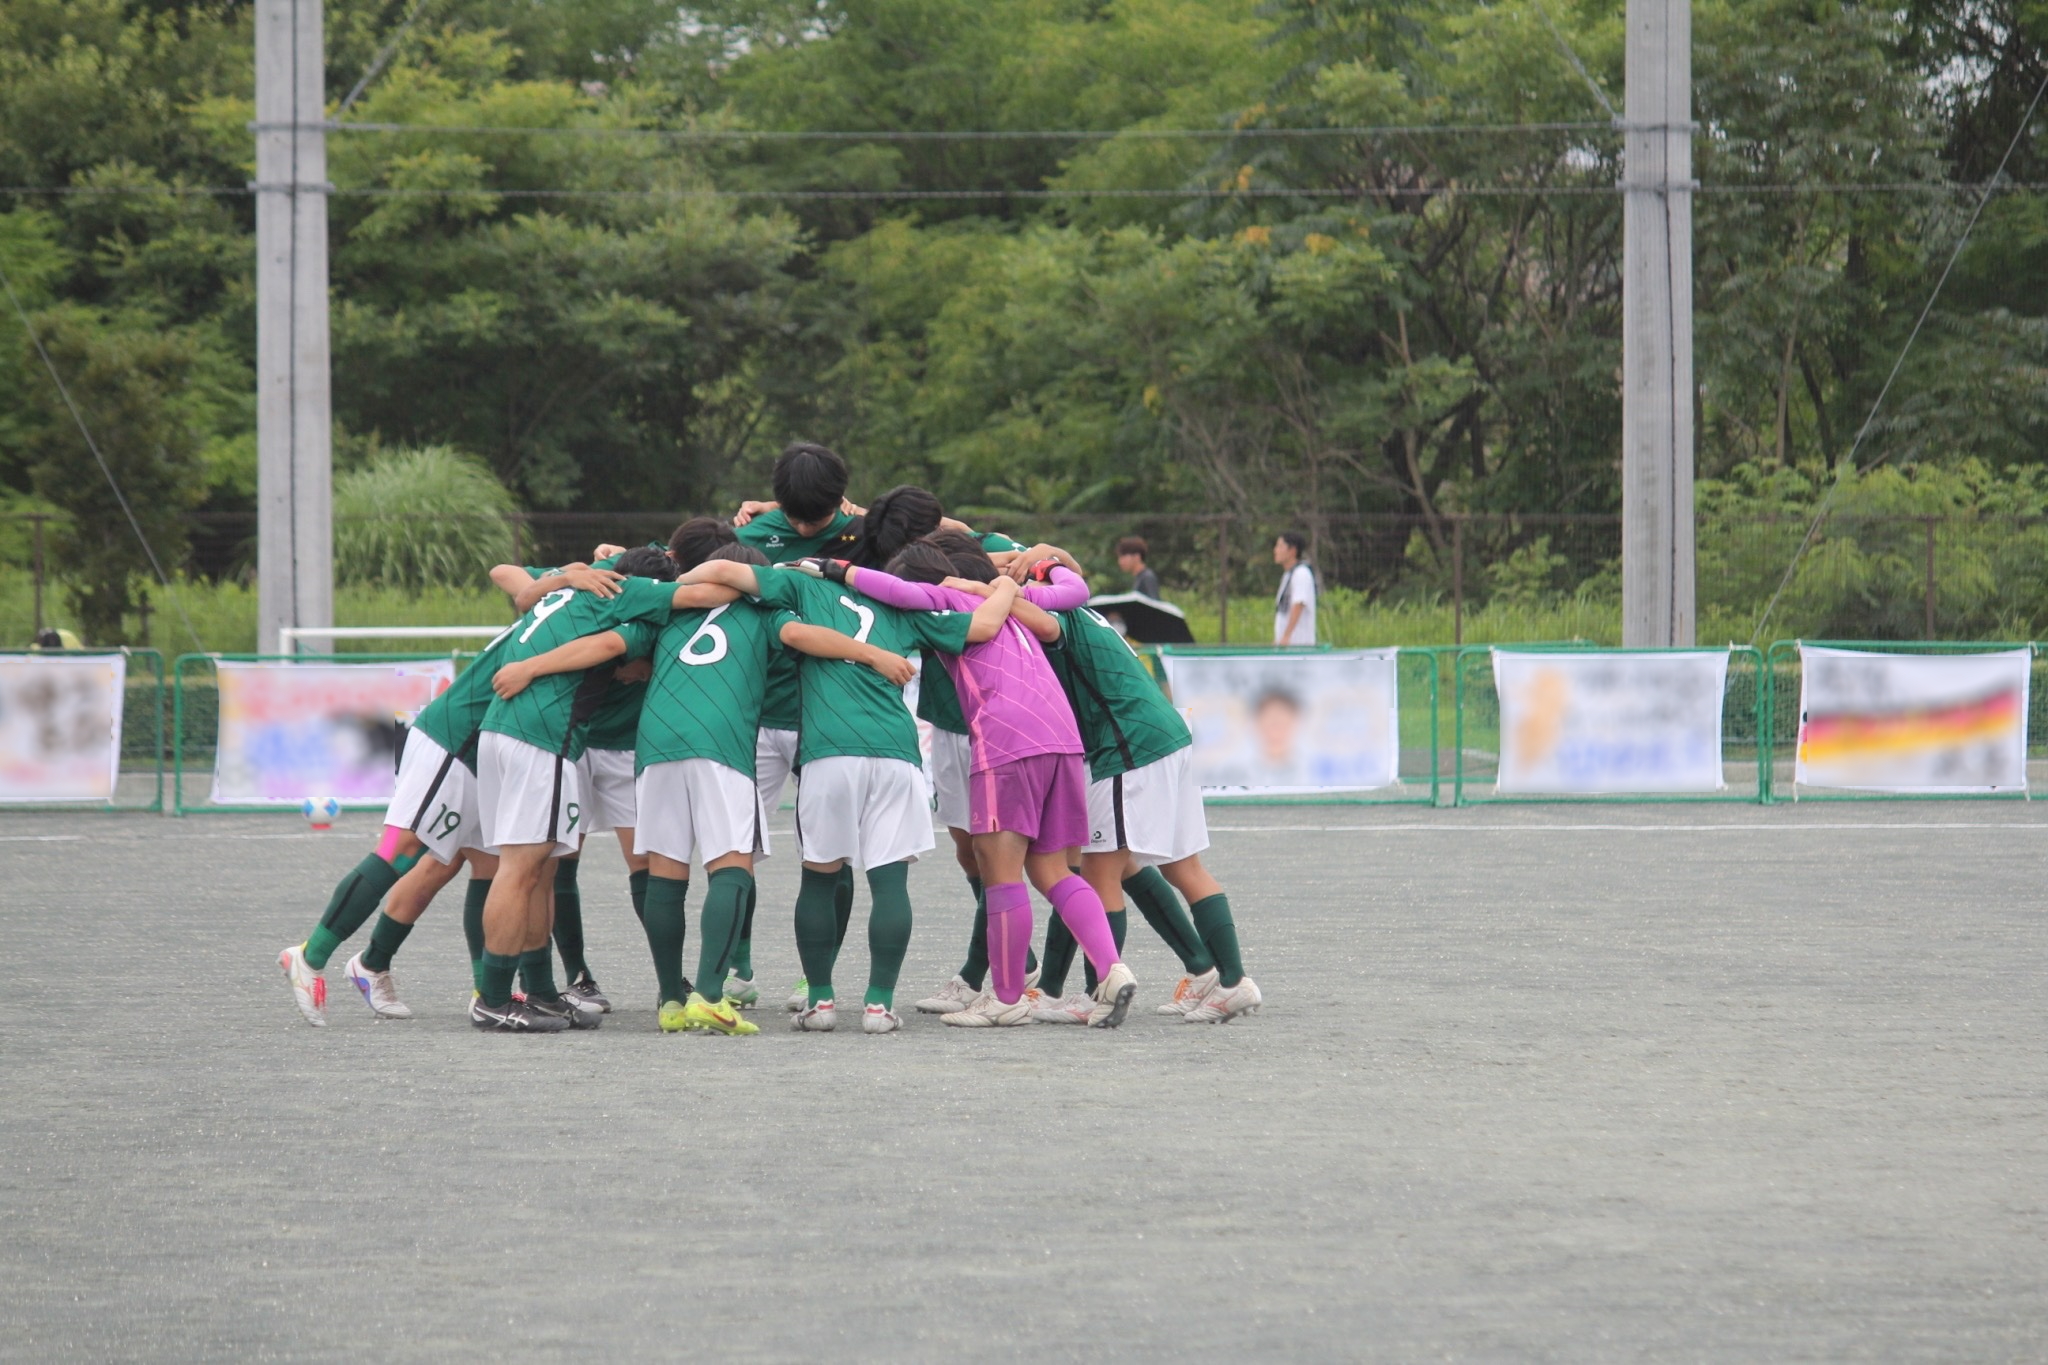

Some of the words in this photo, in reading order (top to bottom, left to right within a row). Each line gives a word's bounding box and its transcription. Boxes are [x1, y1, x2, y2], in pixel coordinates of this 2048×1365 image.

[519, 588, 575, 644] 9
[678, 602, 728, 666] 6
[427, 803, 461, 841] 19
[567, 802, 580, 834] 9
